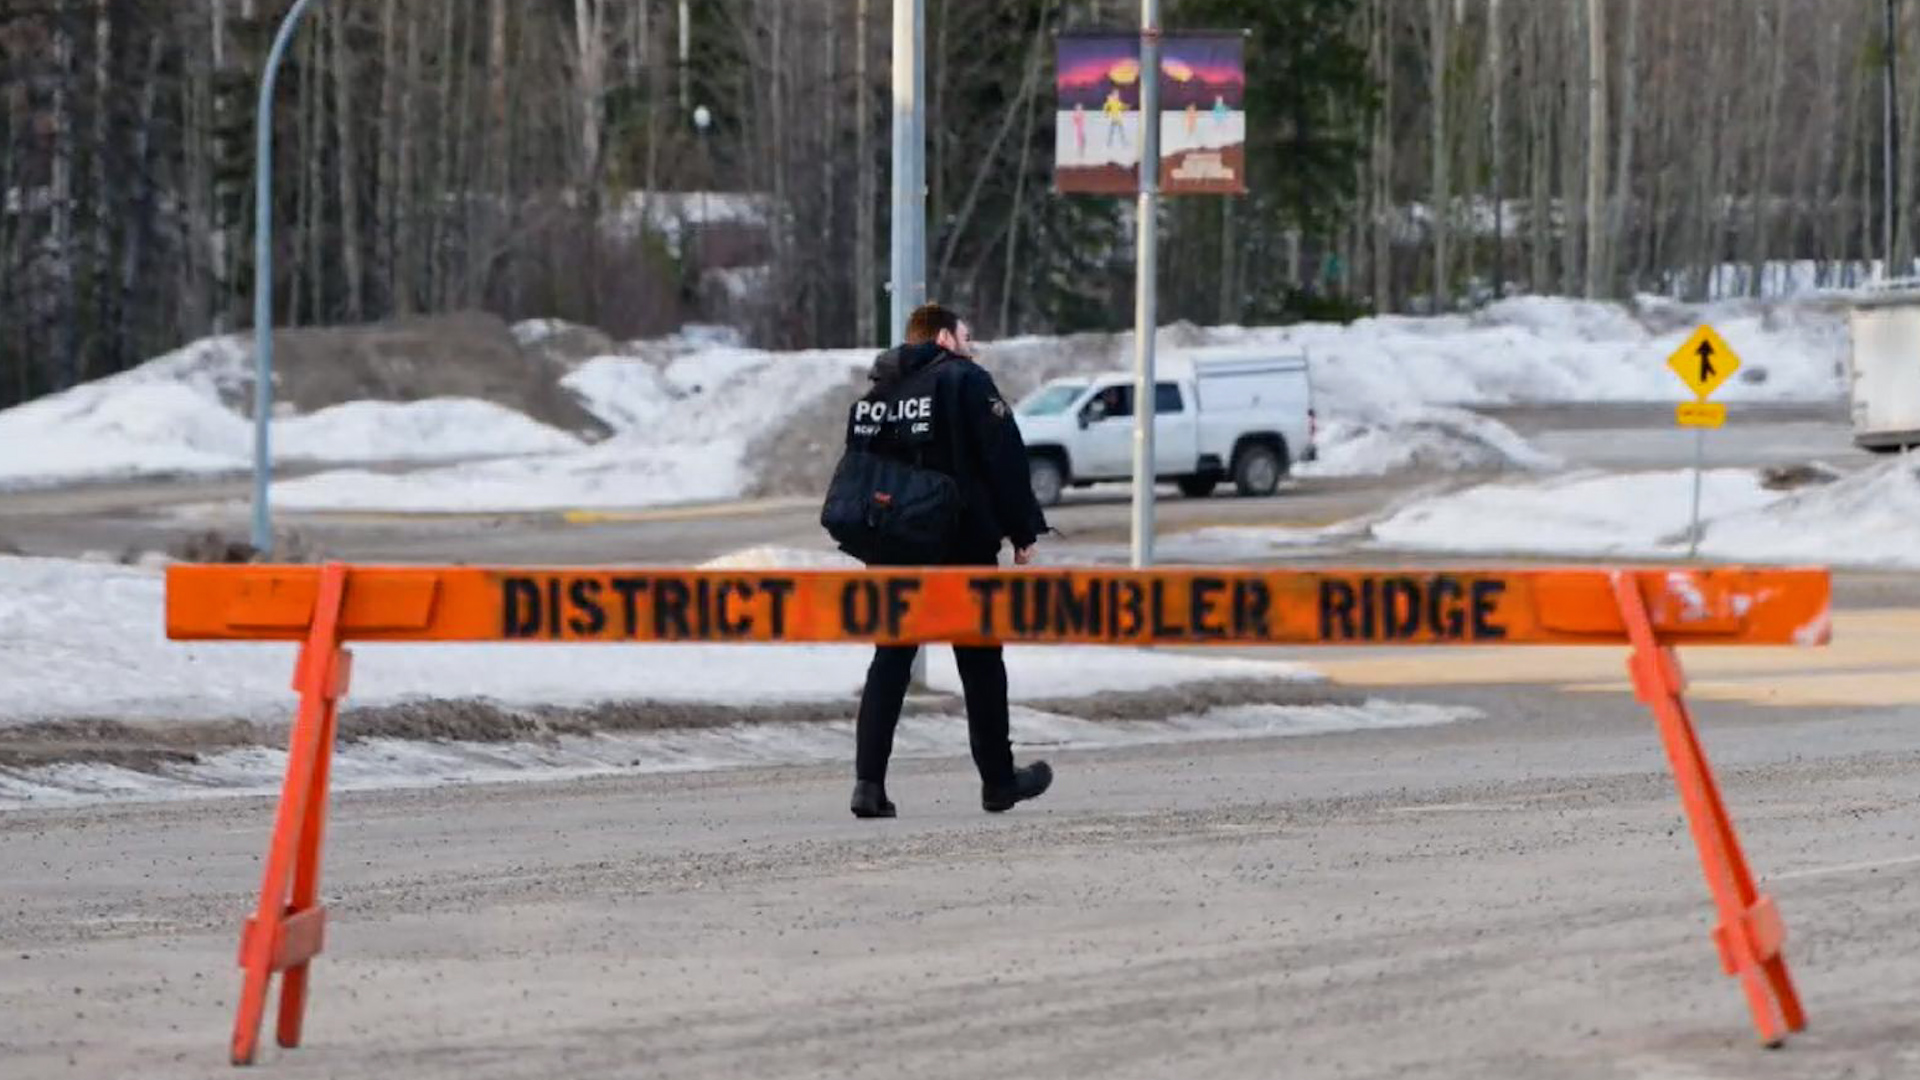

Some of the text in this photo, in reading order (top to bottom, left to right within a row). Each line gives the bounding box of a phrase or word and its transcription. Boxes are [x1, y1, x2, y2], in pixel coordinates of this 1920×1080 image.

[855, 397, 932, 421] POLICE
[503, 577, 1507, 640] DISTRICT OF TUMBLER RIDGE
